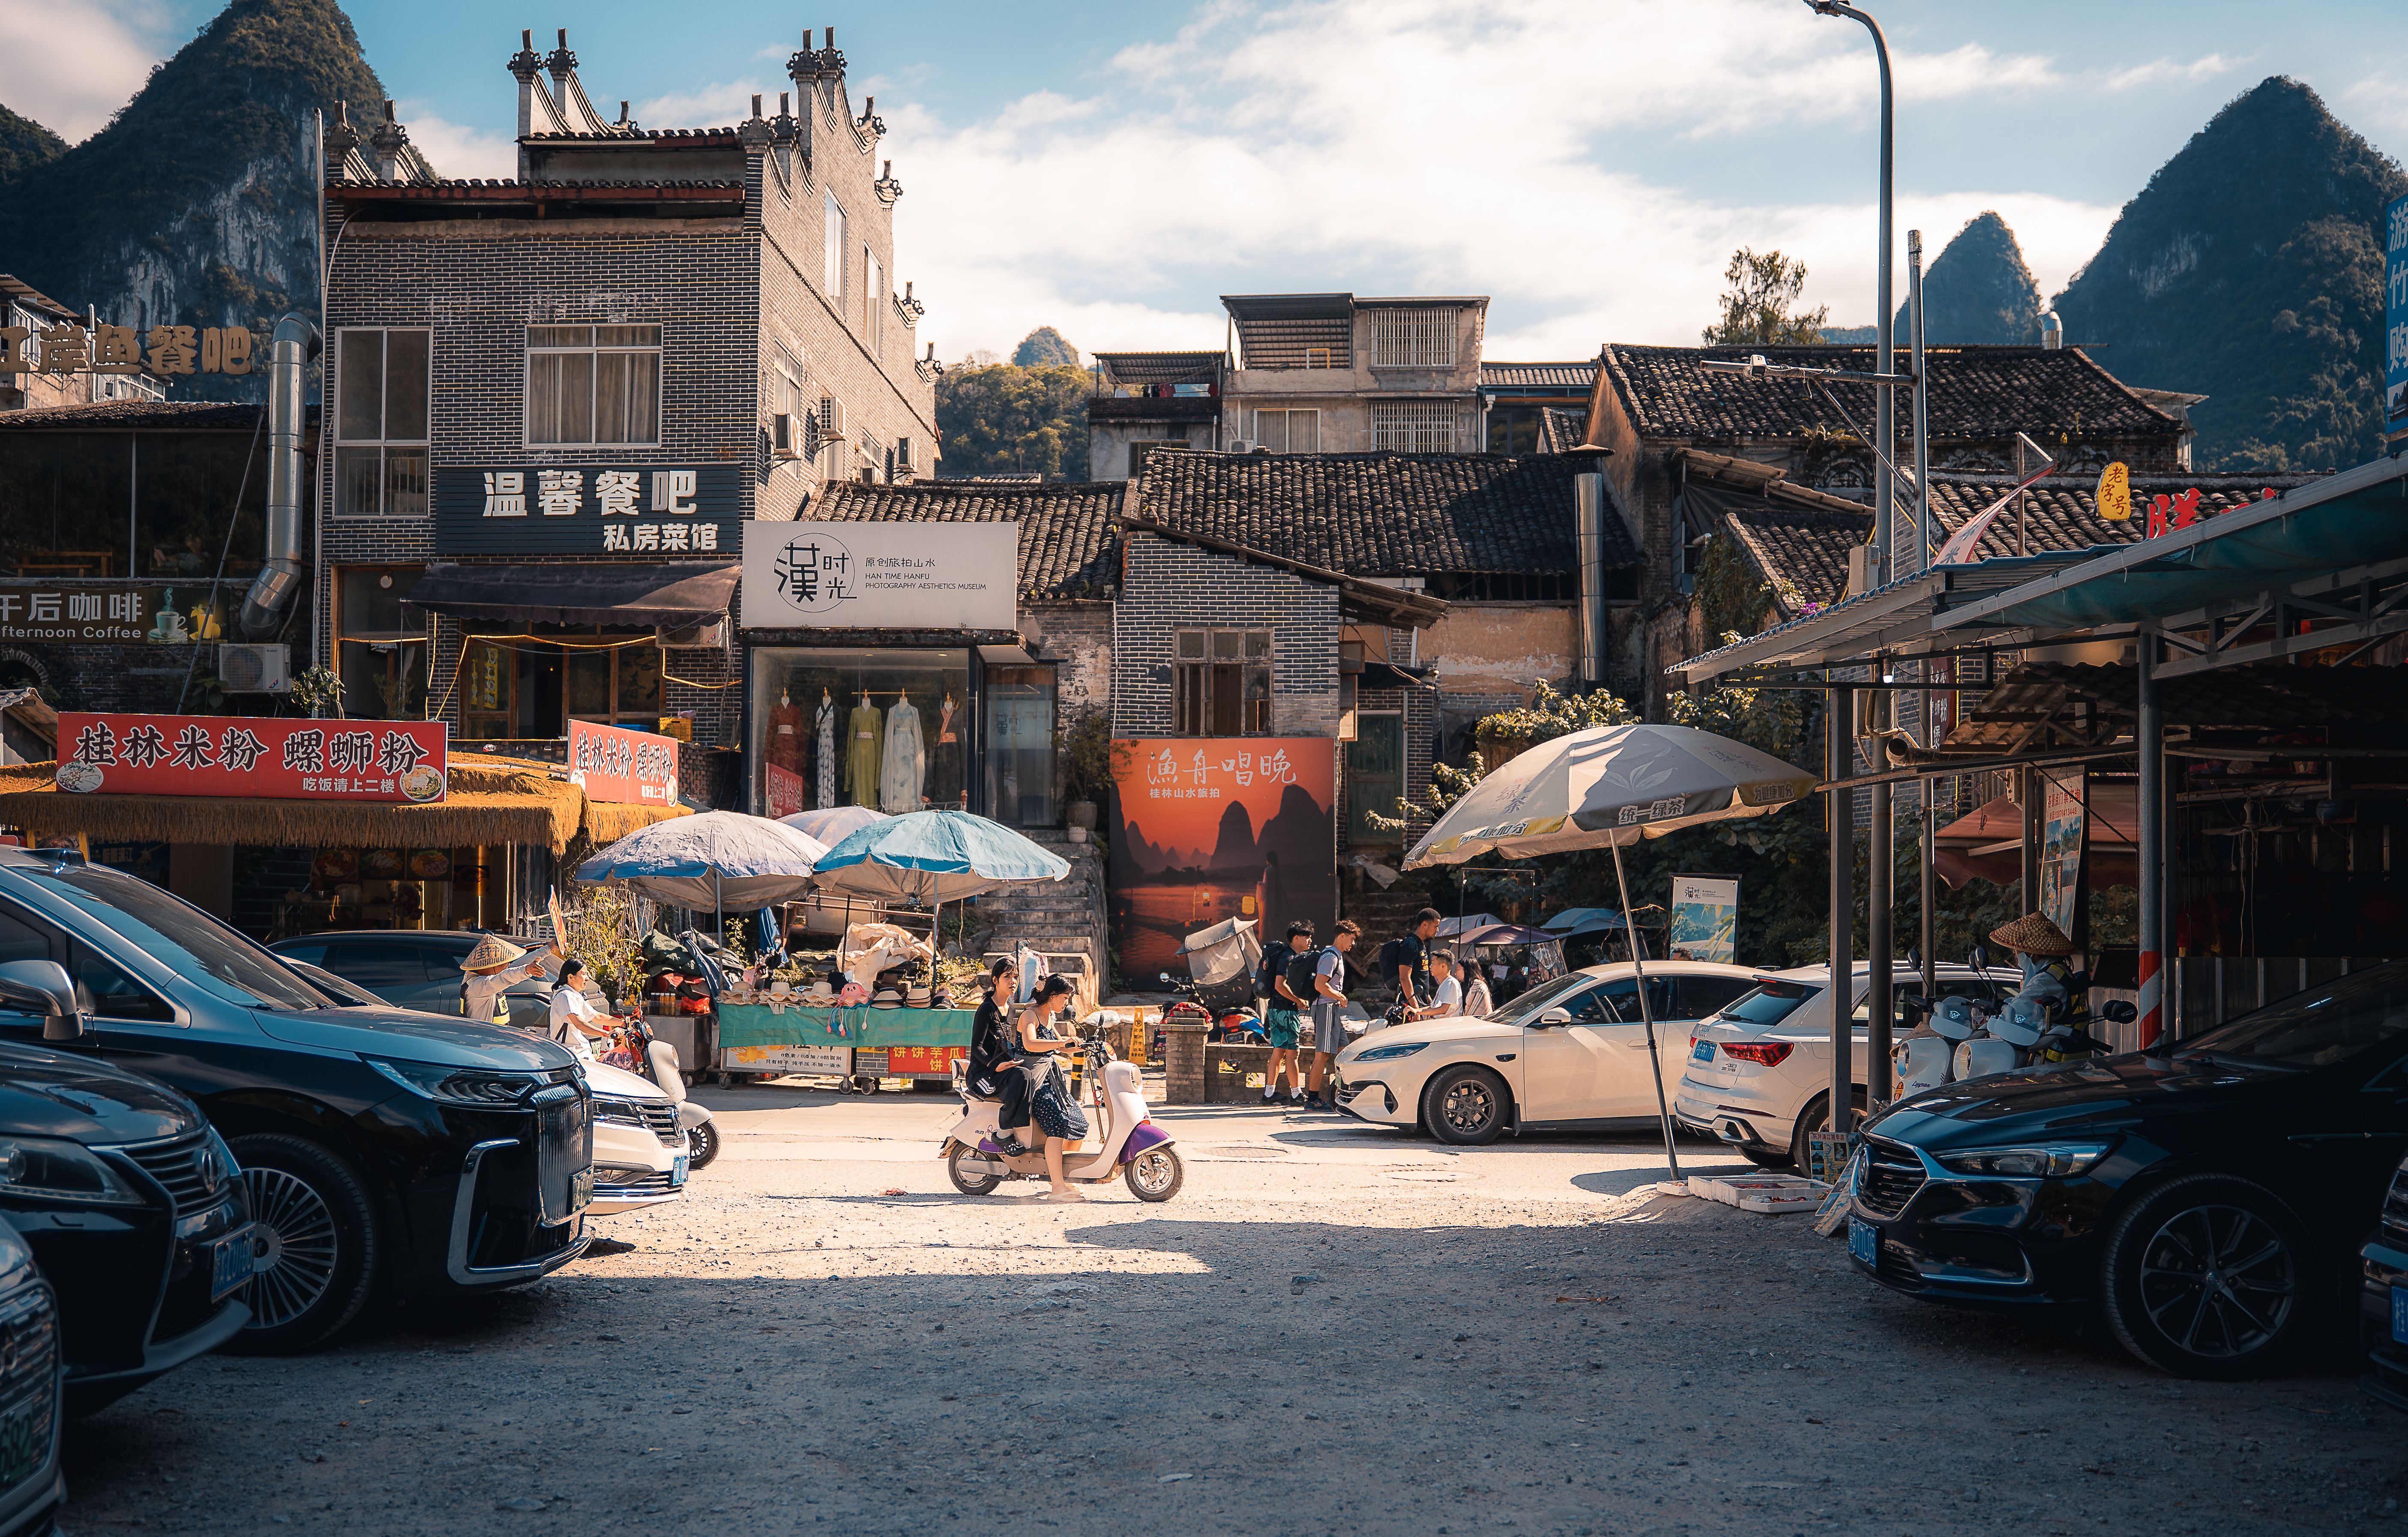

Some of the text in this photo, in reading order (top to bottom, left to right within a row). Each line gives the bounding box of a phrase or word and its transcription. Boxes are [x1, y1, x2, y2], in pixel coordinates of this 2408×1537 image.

[483, 469, 697, 516] 温馨餐吧
[2101, 466, 2127, 516] 老字号
[603, 522, 718, 552] 私房菜馆
[865, 557, 936, 568] 原创旅拍山水
[83, 626, 141, 638] Coffee
[73, 721, 430, 775] 桂林米粉 螺蛳粉
[575, 729, 674, 784] 桂林米粉 螺蛳粉
[1147, 747, 1296, 787] 漁舟唱晚
[302, 777, 395, 794] 吃饭请上二楼
[1150, 788, 1220, 799] 桂林山水旅拍
[1754, 782, 1793, 802] 为健康加分
[1620, 798, 1684, 823] 统一绿茶
